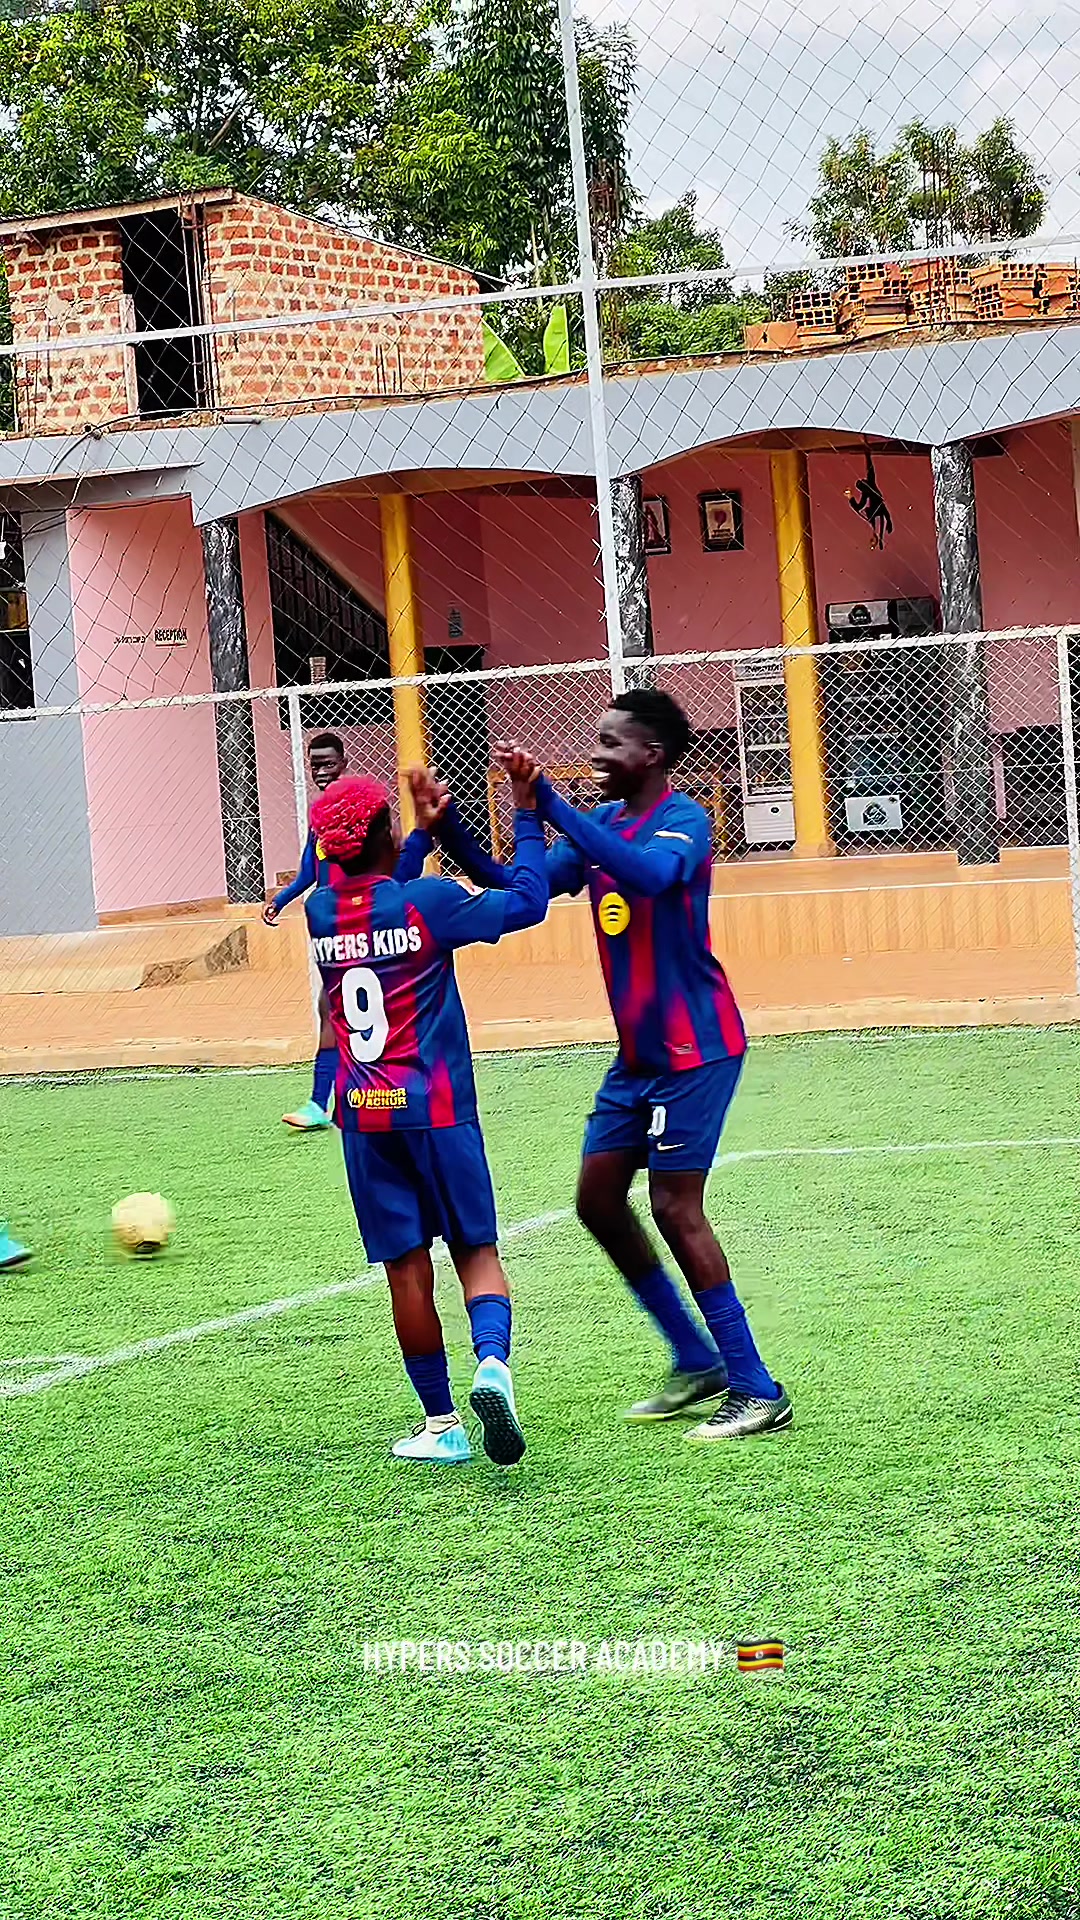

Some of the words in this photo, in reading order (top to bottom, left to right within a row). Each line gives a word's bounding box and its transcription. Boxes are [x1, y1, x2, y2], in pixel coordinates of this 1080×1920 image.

[154, 628, 187, 641] RECEPTION
[372, 925, 422, 957] KIDS
[341, 967, 389, 1063] 9
[366, 1097, 407, 1106] ACNUR
[647, 1105, 667, 1137] 0
